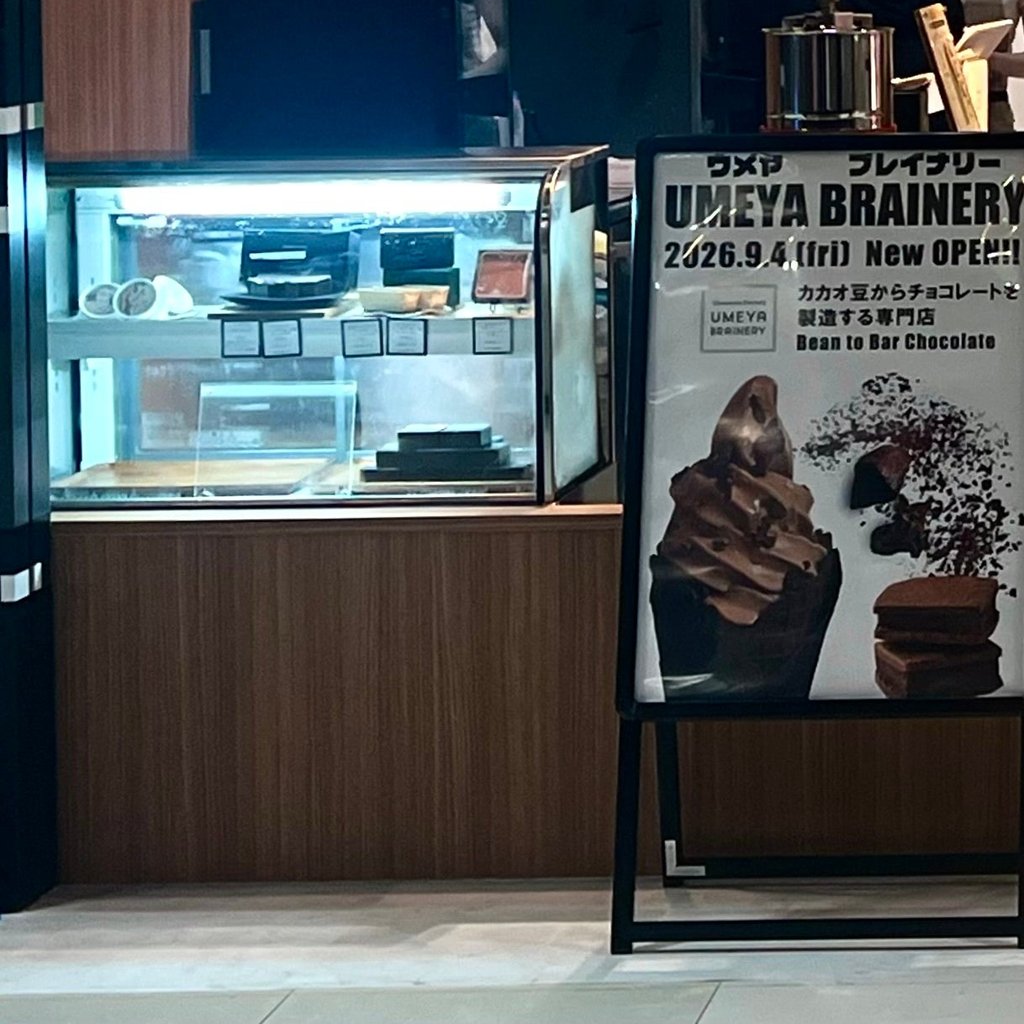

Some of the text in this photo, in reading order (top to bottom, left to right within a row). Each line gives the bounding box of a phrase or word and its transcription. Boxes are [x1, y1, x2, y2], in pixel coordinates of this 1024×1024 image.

[665, 184, 809, 229] UMEYA
[865, 240, 925, 267] New
[932, 239, 1020, 266] OPEN!!
[798, 283, 1019, 302] カカオ豆からチョコレートを
[710, 310, 767, 323] UMEYA
[798, 308, 935, 327] 製造する専門店
[710, 326, 766, 336] BRAINERY
[796, 332, 996, 351] Bean to Bar Chocolate
